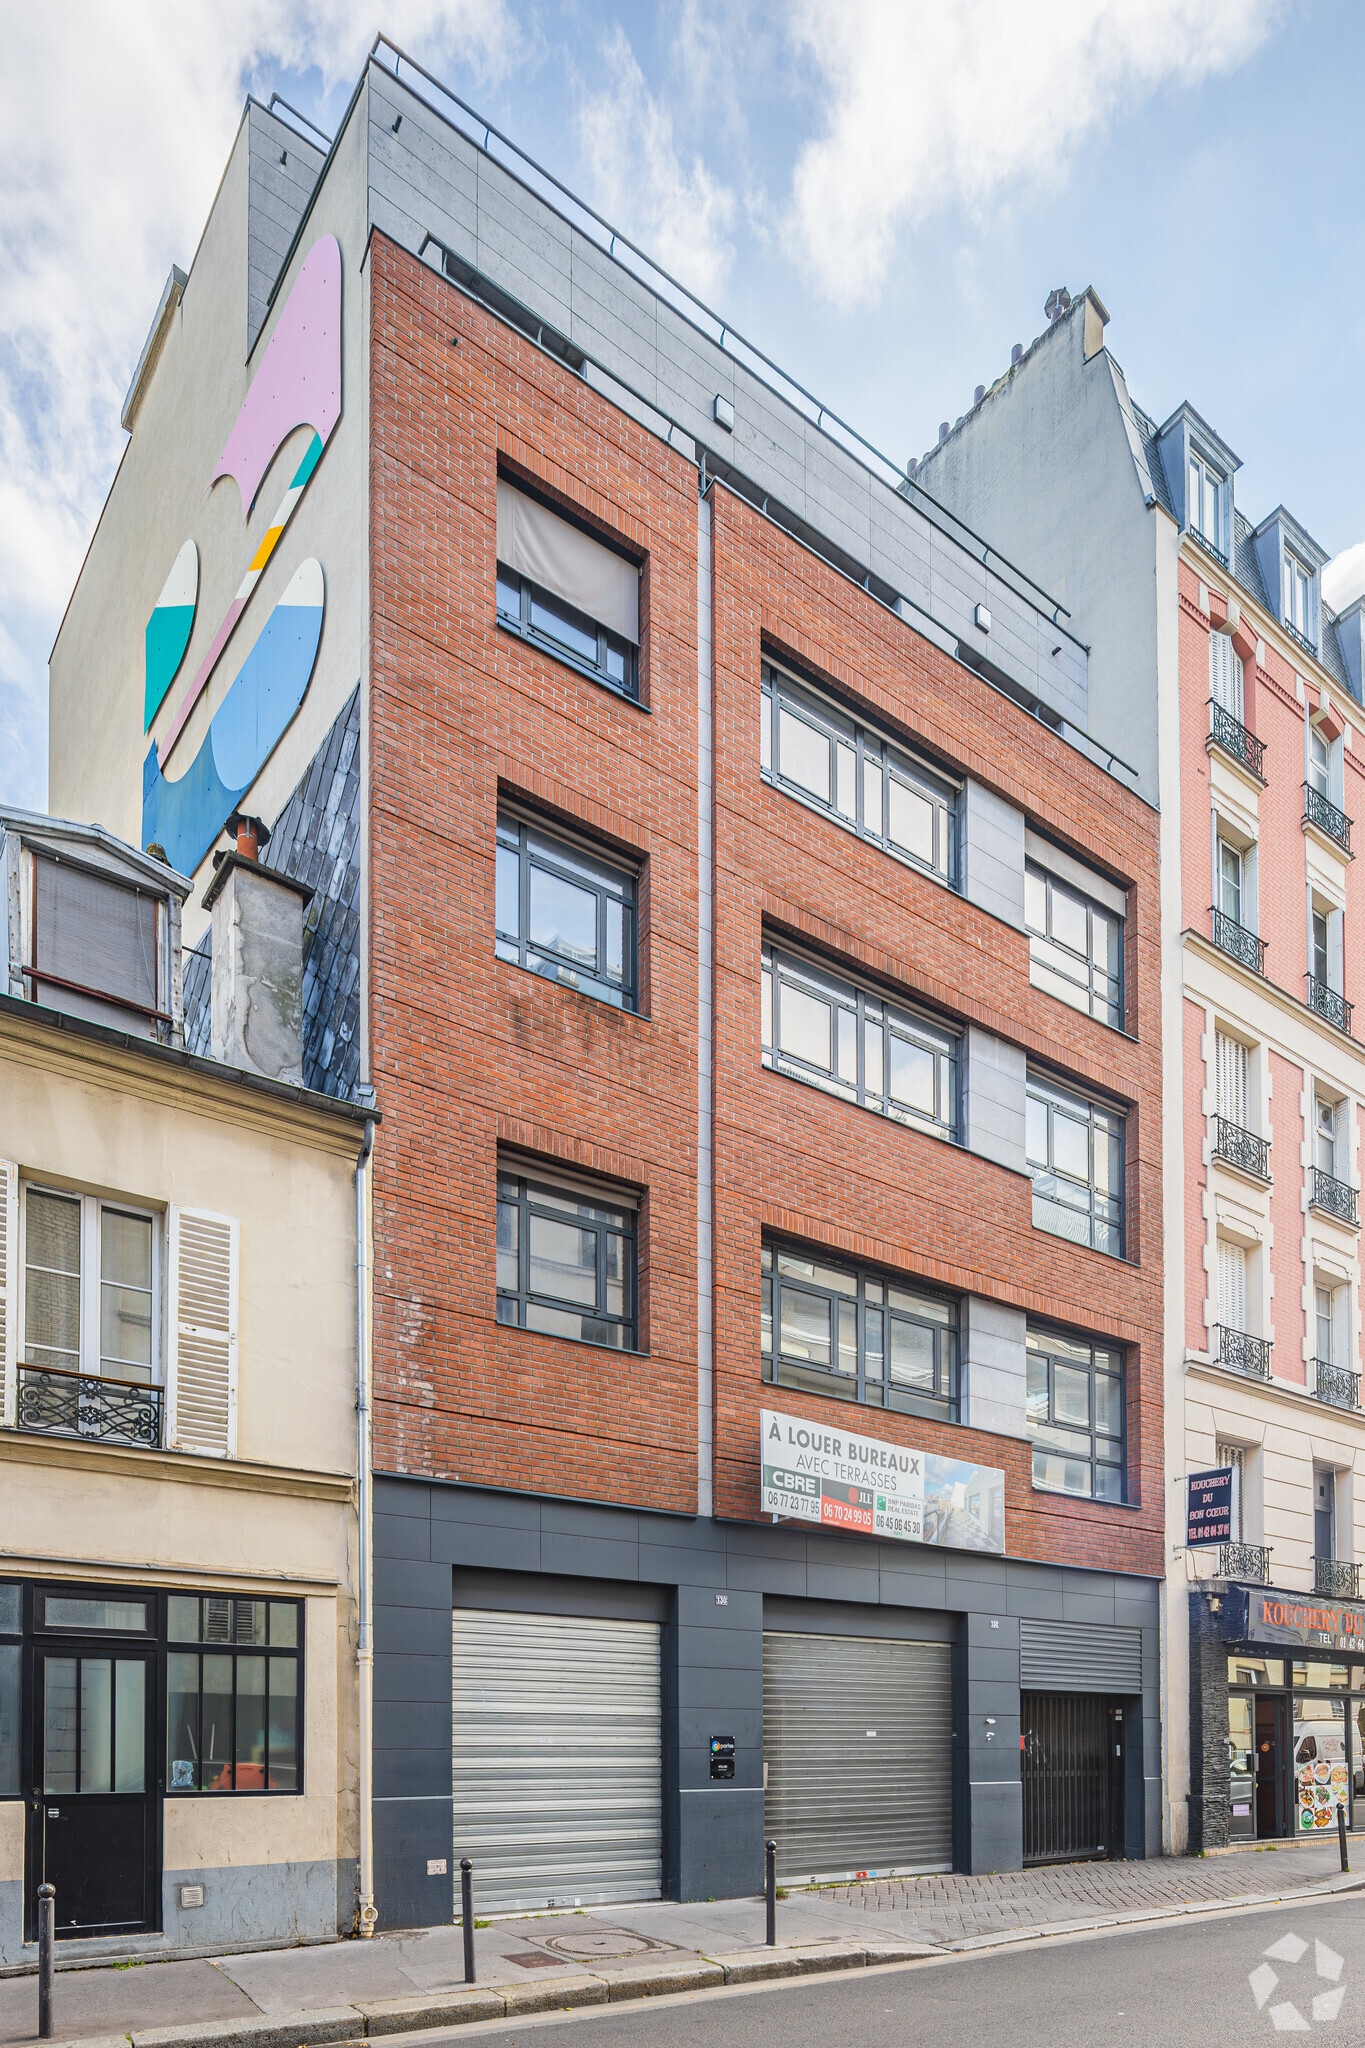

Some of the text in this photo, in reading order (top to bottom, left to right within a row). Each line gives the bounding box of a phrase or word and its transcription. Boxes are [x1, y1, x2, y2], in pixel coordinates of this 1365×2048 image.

[768, 1416, 920, 1475] À LOUER BUREAUX
[772, 1470, 816, 1494] CBRE
[796, 1454, 897, 1491] AVEC TERRASSES
[1190, 1473, 1231, 1491] KOUCHERY
[768, 1491, 820, 1514] 06 77 23 77 95
[887, 1498, 921, 1510] BNP PARIBAS
[1202, 1493, 1213, 1504] DU
[823, 1503, 872, 1526] 06 70 24 99 05
[887, 1506, 919, 1517] REAL ESTATE
[1189, 1509, 1205, 1521] BON
[876, 1514, 884, 1528] 06
[885, 1516, 893, 1530] 45
[894, 1518, 902, 1531] 06
[903, 1520, 911, 1533] 45
[912, 1521, 920, 1534] 30
[1262, 1601, 1363, 1635] KOUCHERY DU
[1339, 1636, 1346, 1648] 01
[1357, 1638, 1365, 1650] 64
